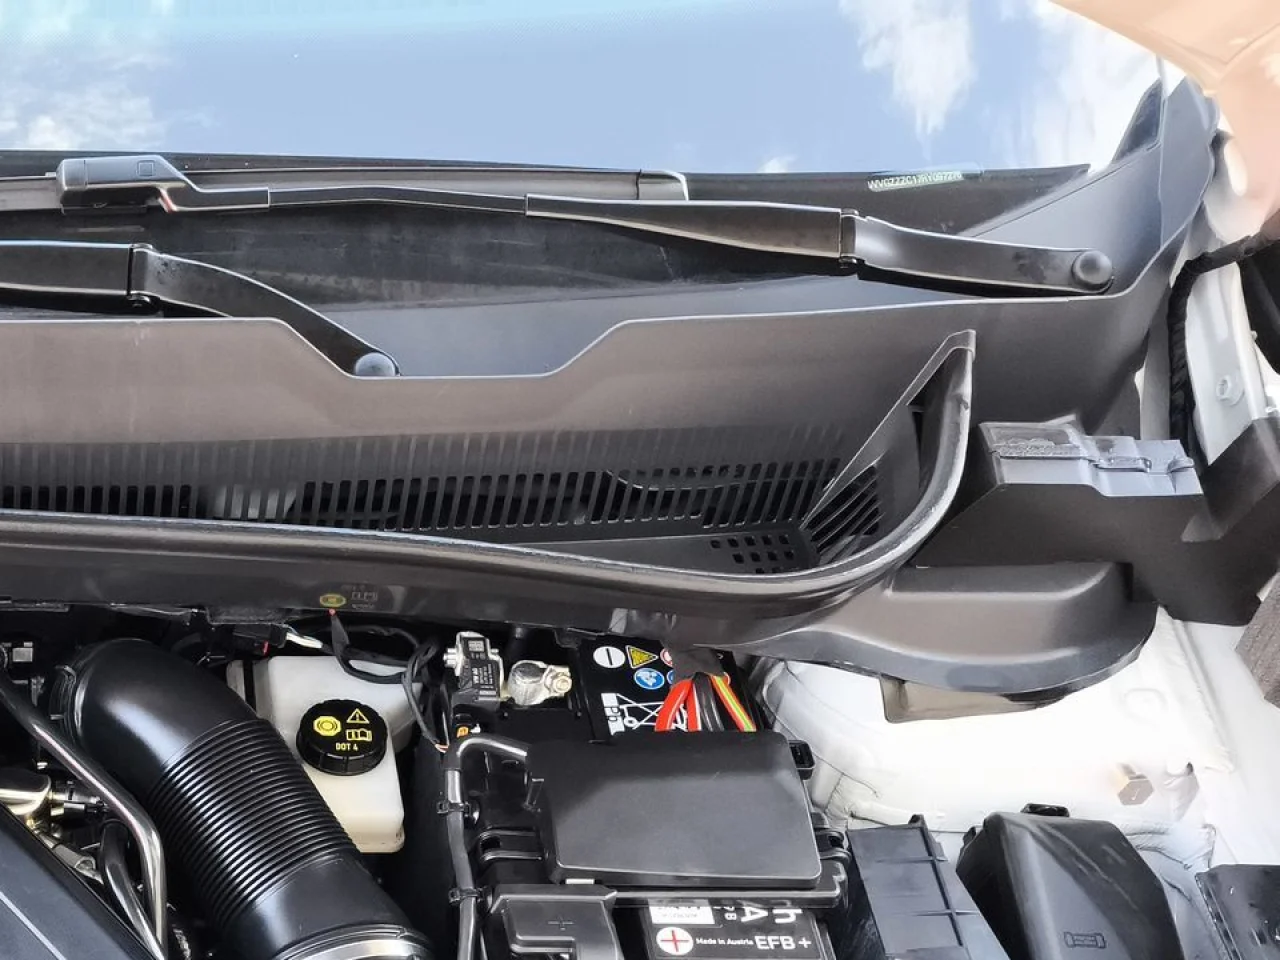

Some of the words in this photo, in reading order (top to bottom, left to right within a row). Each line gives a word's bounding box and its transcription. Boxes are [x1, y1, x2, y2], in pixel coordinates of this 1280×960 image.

[335, 743, 351, 751] DOT
[353, 743, 359, 751] 4
[726, 938, 754, 946] Austria
[754, 935, 796, 950] EFB
[799, 937, 812, 949] +
